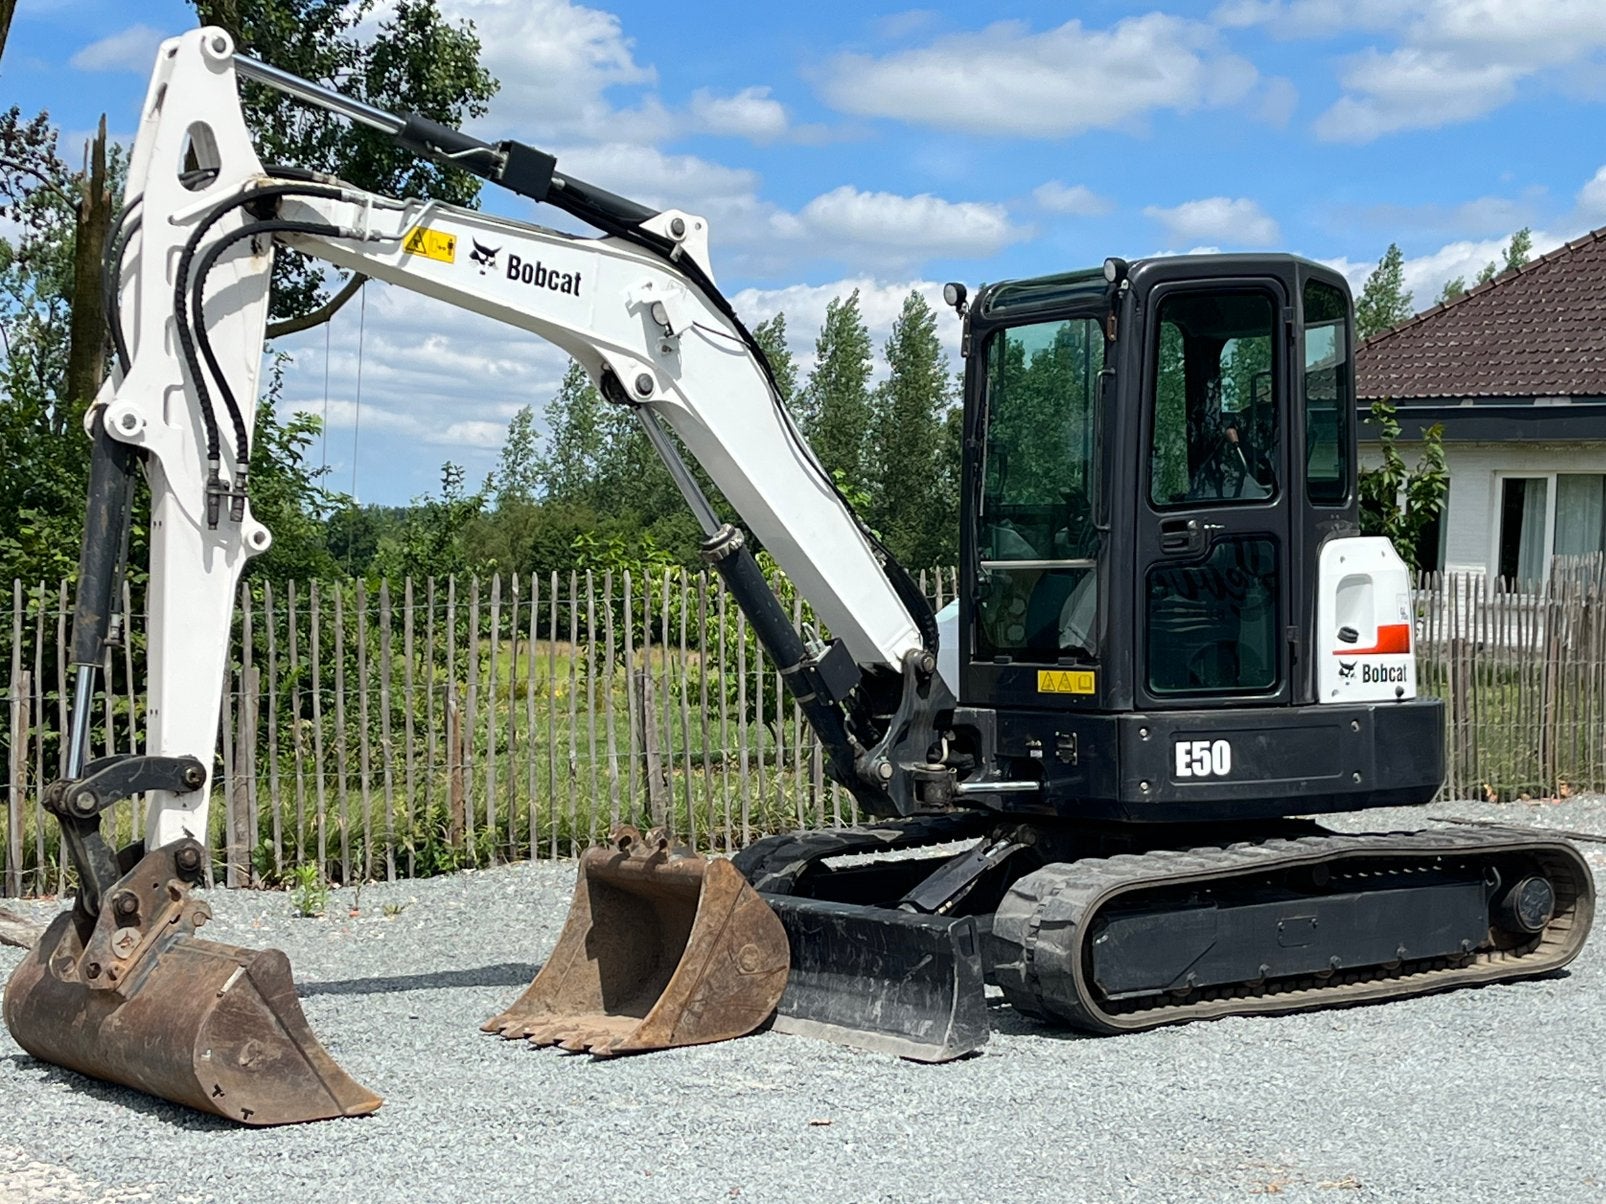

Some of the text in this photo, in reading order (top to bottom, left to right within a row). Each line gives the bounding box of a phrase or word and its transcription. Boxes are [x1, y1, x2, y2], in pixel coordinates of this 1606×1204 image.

[506, 253, 582, 297] Bobcat
[1362, 663, 1407, 683] Bobcat
[1175, 740, 1231, 777] E50
